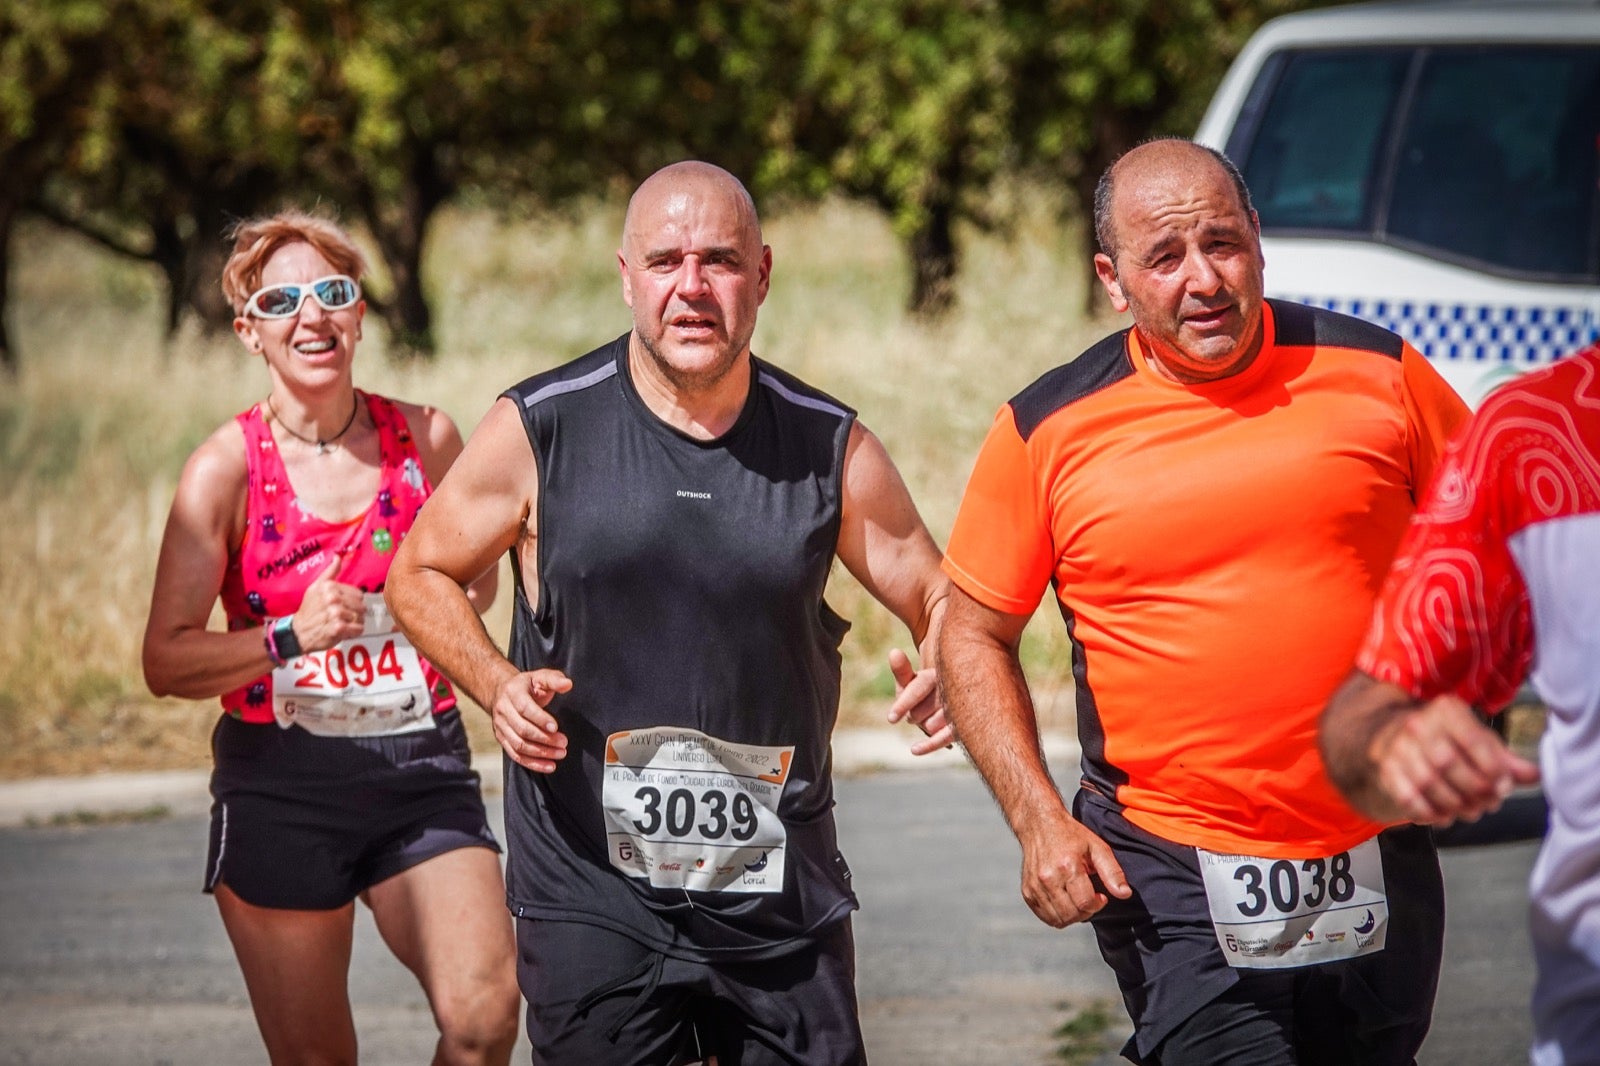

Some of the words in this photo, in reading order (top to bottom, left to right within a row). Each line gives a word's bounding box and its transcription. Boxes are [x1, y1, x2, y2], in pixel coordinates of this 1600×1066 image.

[676, 490, 712, 499] OUTSHOCK
[294, 640, 404, 689] 2094
[672, 751, 705, 763] UNIVERSO
[632, 786, 758, 841] 3039
[1233, 852, 1356, 917] 3038
